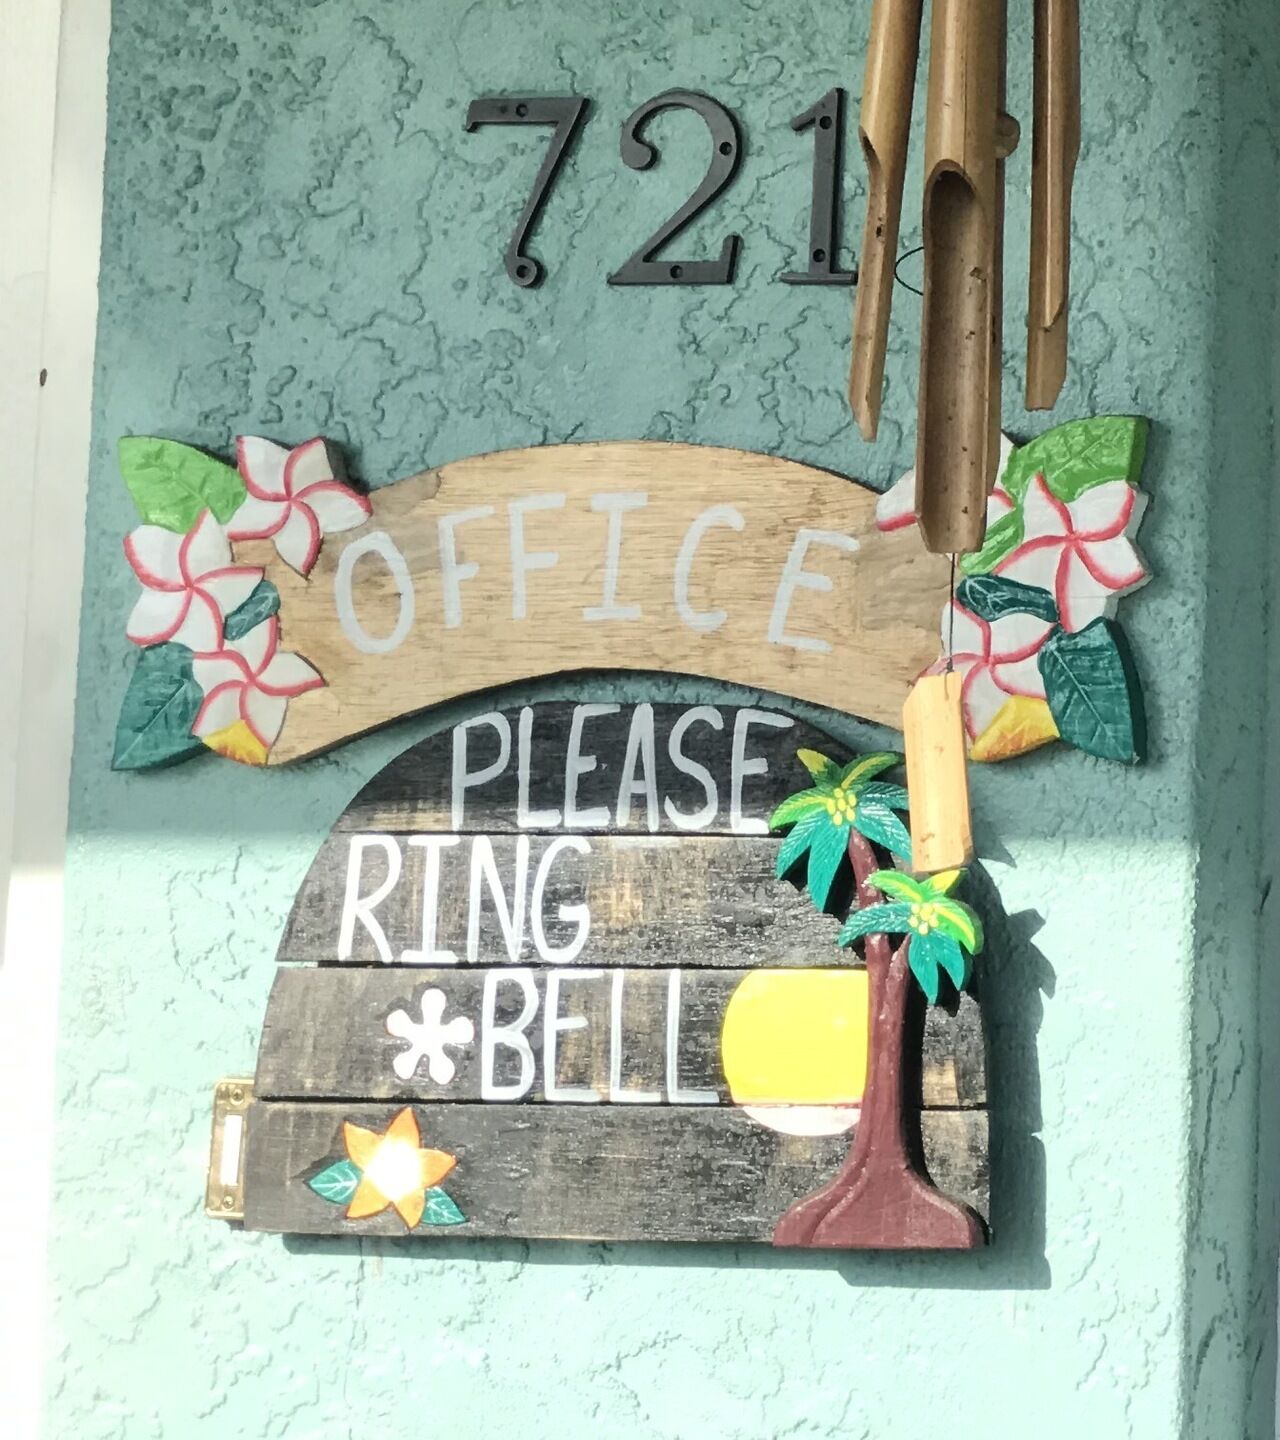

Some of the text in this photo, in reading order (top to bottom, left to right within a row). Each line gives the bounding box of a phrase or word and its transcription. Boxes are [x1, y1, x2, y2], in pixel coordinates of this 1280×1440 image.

[465, 86, 861, 288] 721
[333, 490, 862, 658] OFFICE
[450, 703, 800, 833] PLEASE
[335, 832, 594, 967] RING
[478, 966, 721, 1103] BELL
